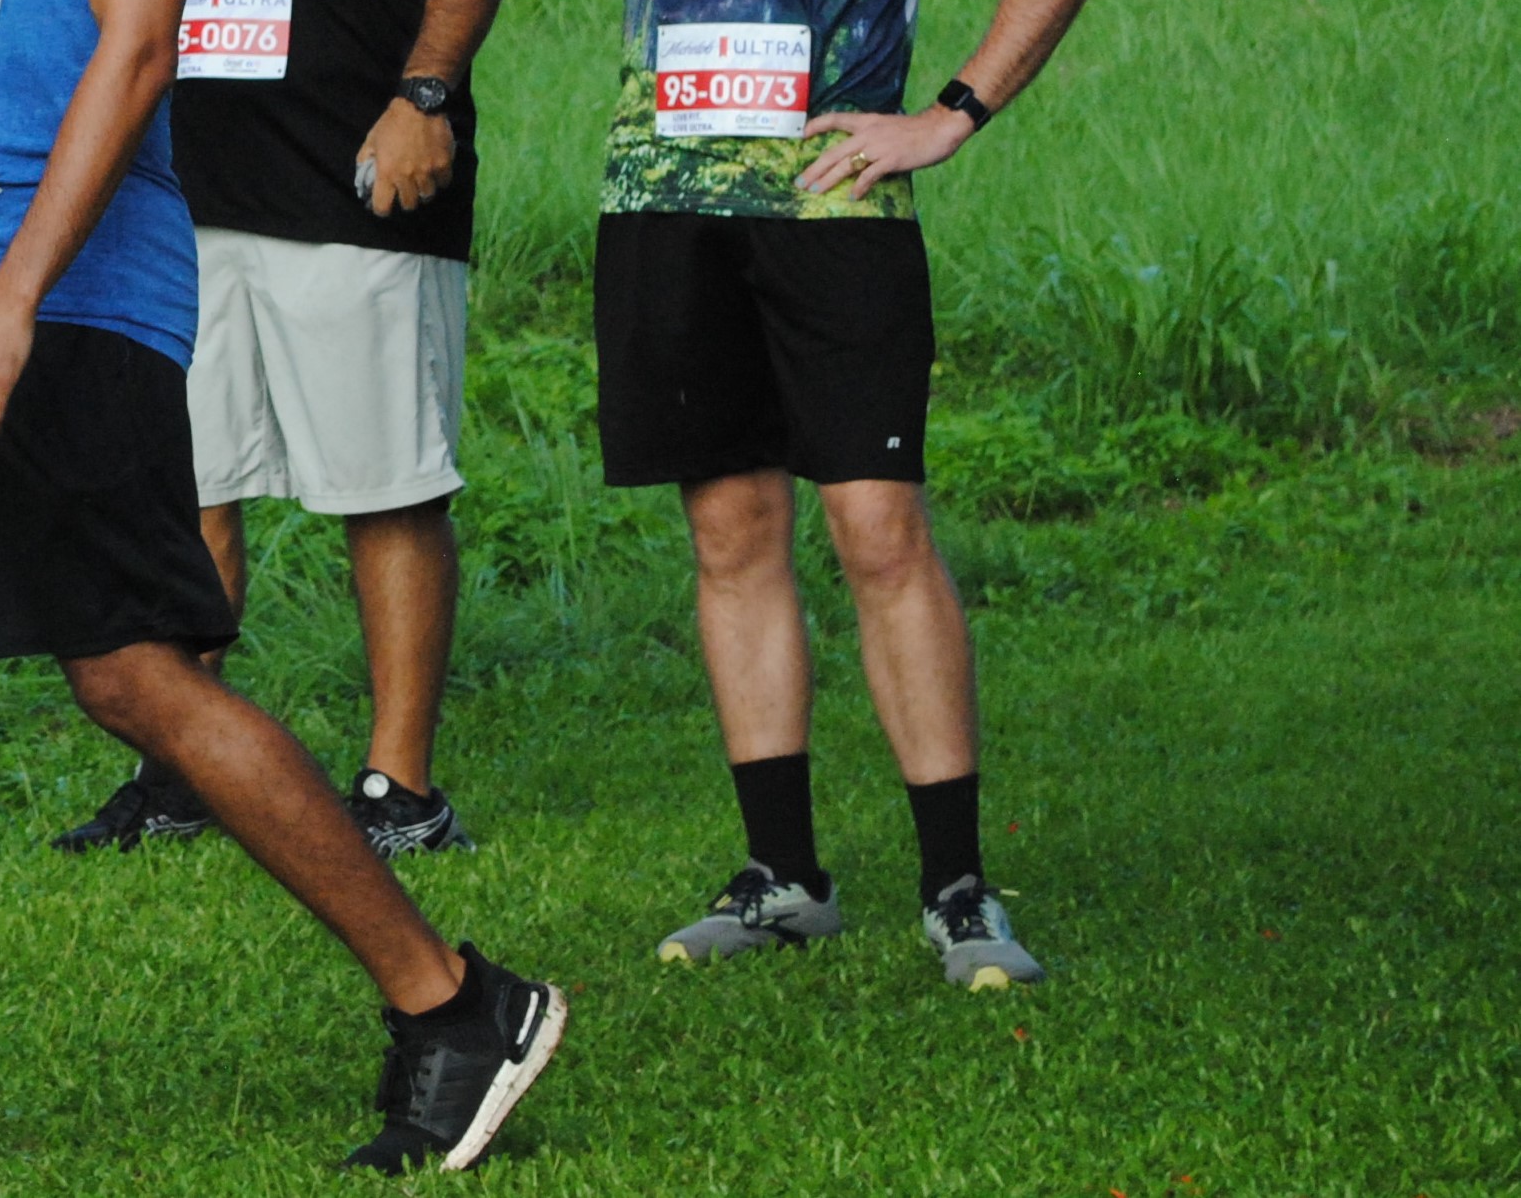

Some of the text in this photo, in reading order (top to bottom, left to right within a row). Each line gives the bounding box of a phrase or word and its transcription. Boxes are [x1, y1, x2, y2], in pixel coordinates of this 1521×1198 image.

[178, 22, 277, 52] 5-0076
[733, 39, 806, 56] ULTRA
[663, 73, 798, 108] 95-0073
